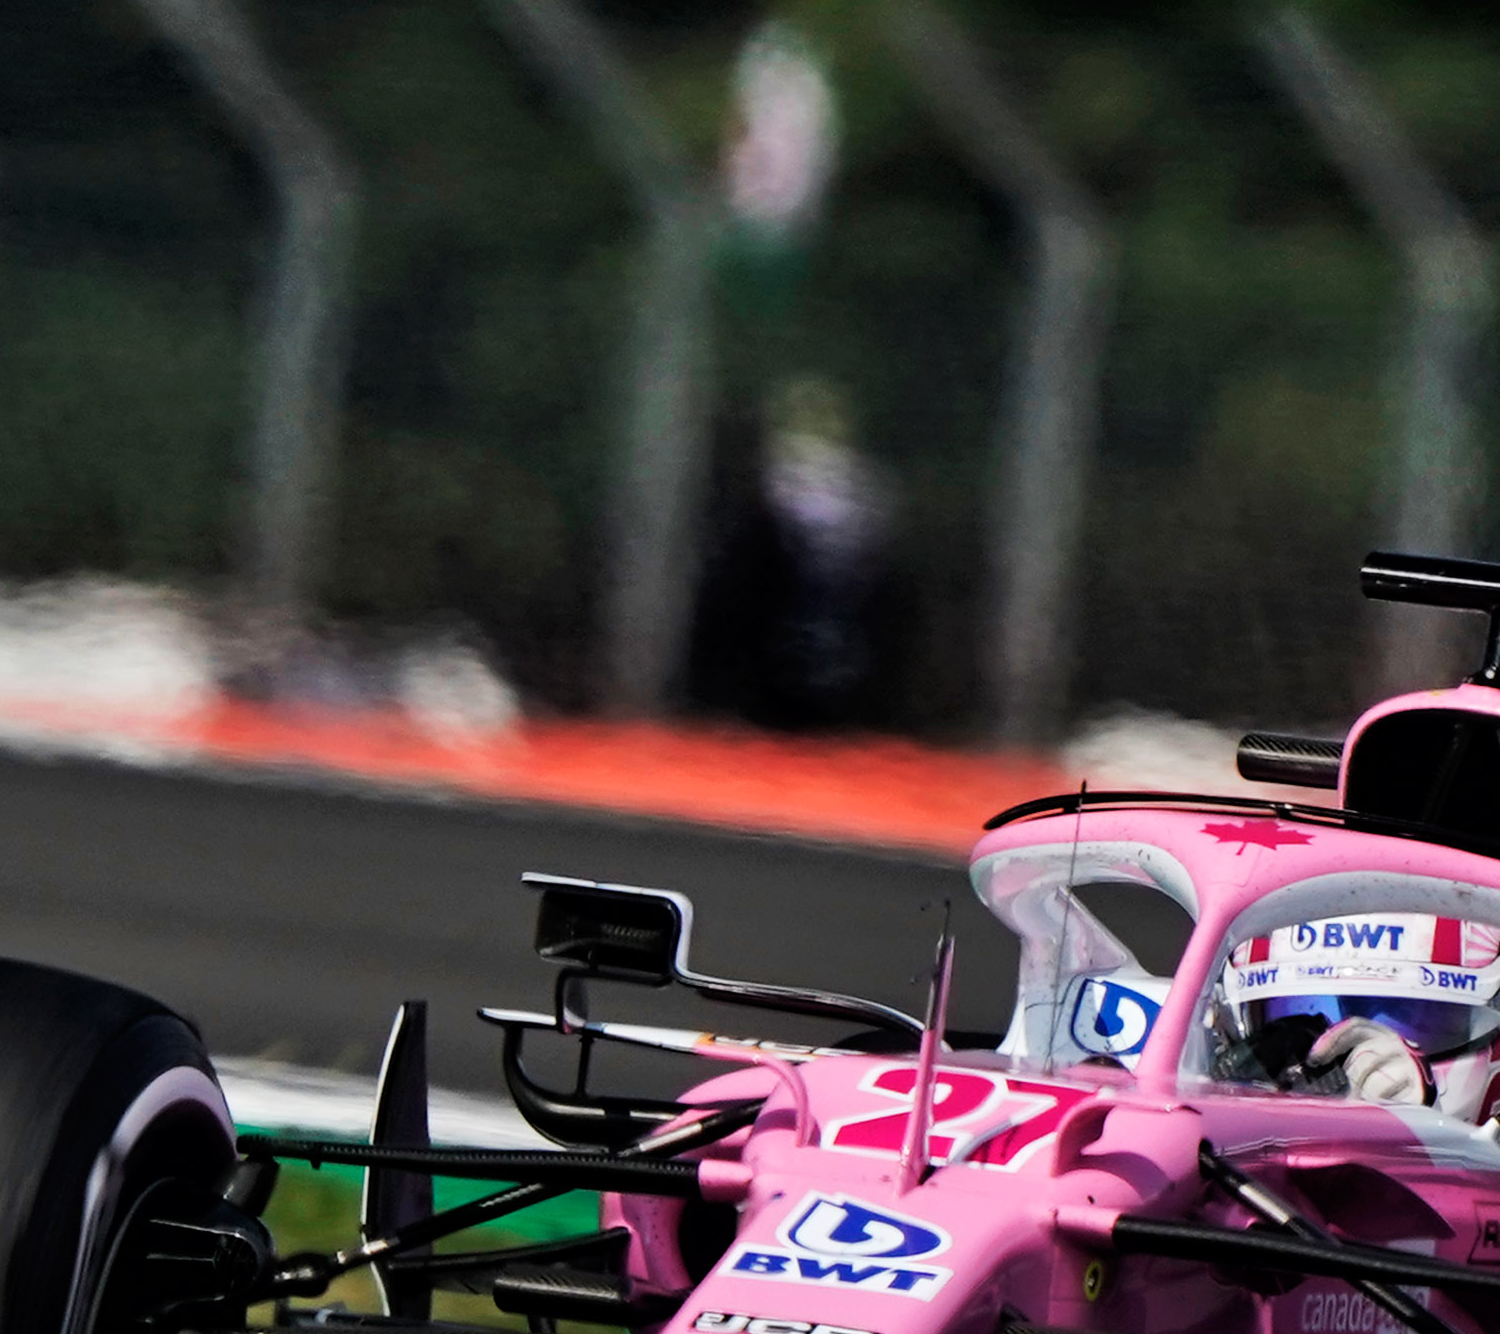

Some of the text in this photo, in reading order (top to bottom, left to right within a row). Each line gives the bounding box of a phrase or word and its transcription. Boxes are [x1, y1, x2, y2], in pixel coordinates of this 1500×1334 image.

[1323, 922, 1404, 950] BWT
[1245, 968, 1279, 986] BWT
[1438, 970, 1478, 992] BWT
[822, 1064, 1100, 1171] 27
[732, 1251, 938, 1292] BWT
[1301, 1289, 1376, 1333] canada
